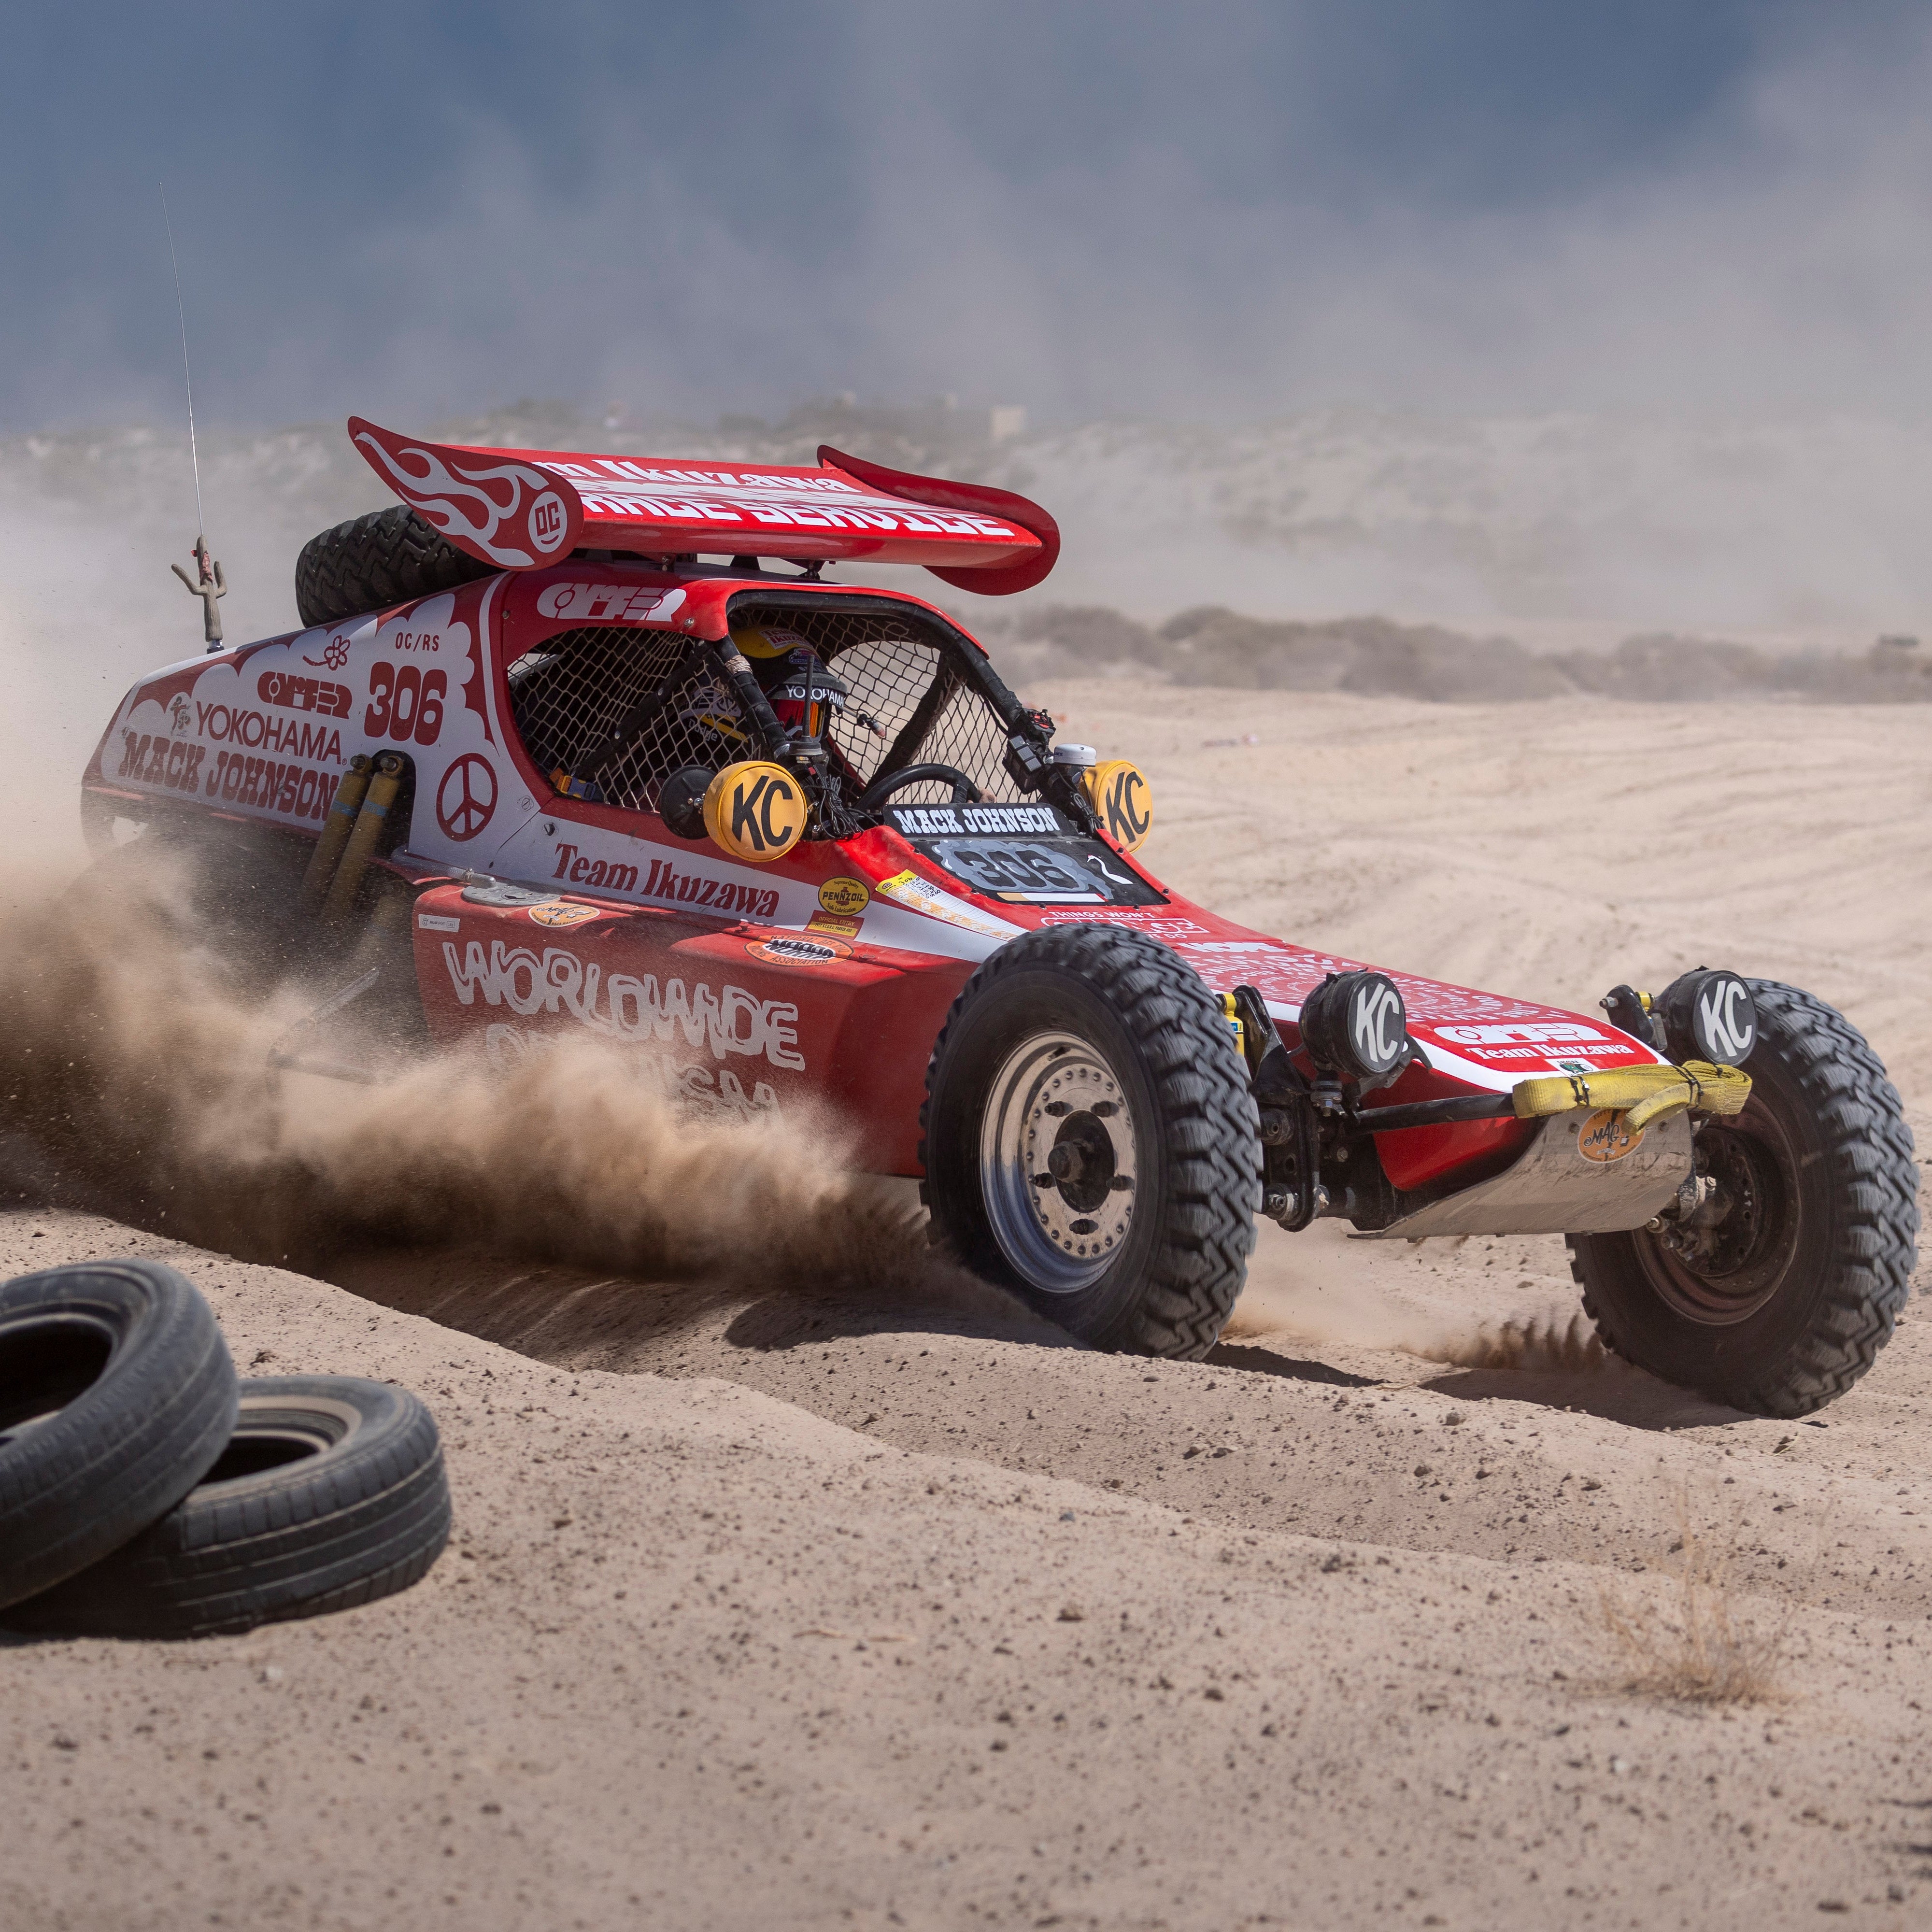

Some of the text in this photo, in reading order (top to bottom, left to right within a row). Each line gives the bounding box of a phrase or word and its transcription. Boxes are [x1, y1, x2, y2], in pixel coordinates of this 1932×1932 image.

[592, 460, 862, 493] Ikuzawa
[535, 501, 560, 536] OC
[579, 492, 1015, 536] RACE SERVICE
[395, 631, 440, 652] OC/RS
[364, 661, 447, 746] 306
[196, 701, 342, 765] YOKOHAMA
[688, 718, 718, 742] Dodge
[119, 732, 340, 821] MACK JOHNSON
[732, 775, 793, 852] KC
[894, 808, 1061, 834] MACK JOHNSON
[1106, 771, 1150, 843] KC
[552, 843, 779, 917] Team Ikuzawa
[822, 891, 865, 902] PENNZOIL
[770, 955, 829, 965] ASSOCIATION
[442, 940, 805, 1071] WORLDWIDE
[1356, 983, 1400, 1063] KC
[1700, 980, 1752, 1057] KC
[1465, 1044, 1635, 1060] Team Ikuzawa
[1584, 1121, 1619, 1147] MAG
